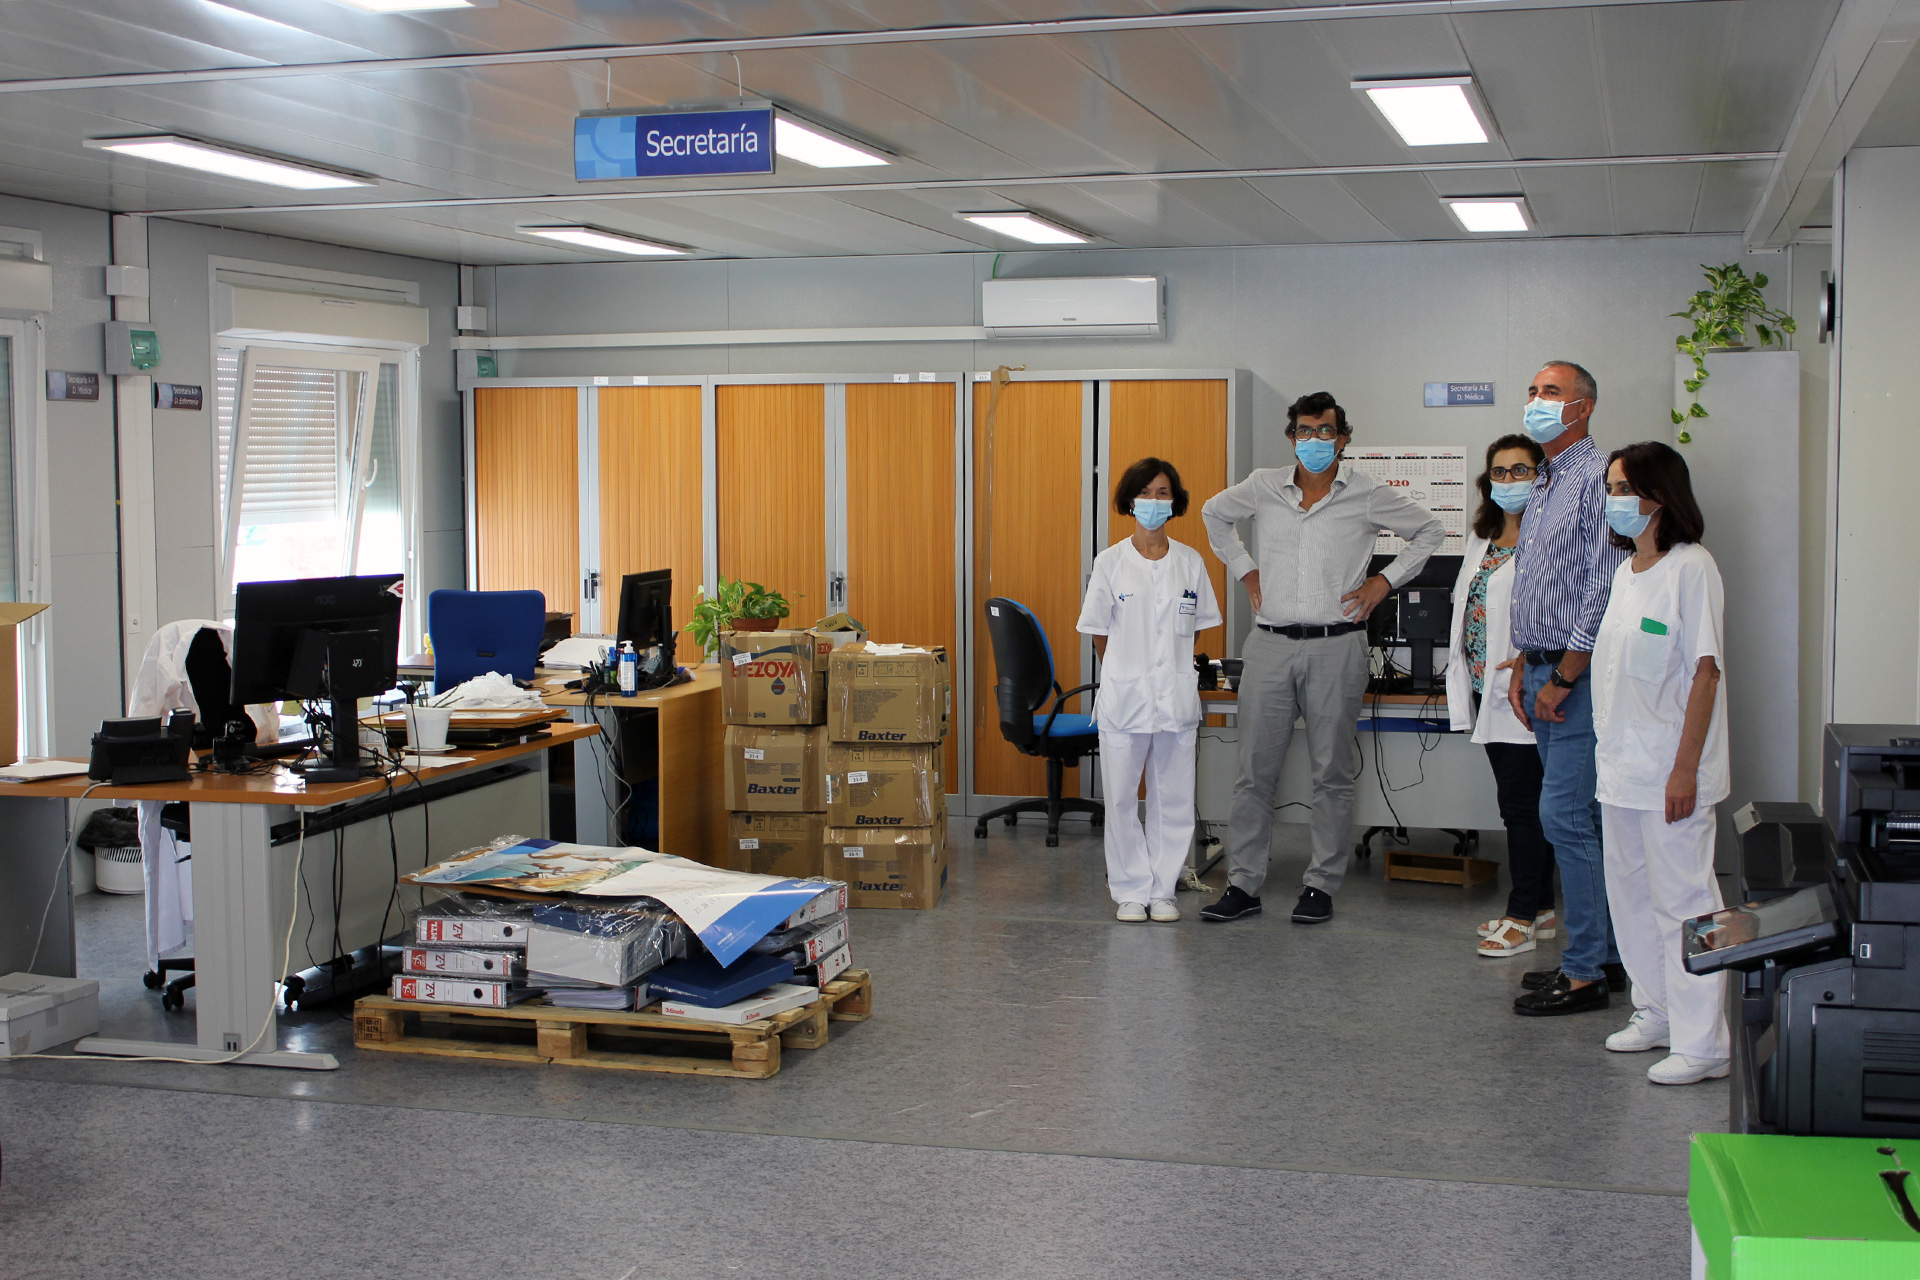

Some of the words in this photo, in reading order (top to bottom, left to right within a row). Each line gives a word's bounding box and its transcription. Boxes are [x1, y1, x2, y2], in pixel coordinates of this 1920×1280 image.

[646, 122, 758, 157] Secretaría
[1450, 384, 1478, 392] Secretaría
[1464, 393, 1484, 401] Médica
[857, 731, 907, 741] Baxter
[747, 783, 801, 795] Baxter
[855, 815, 904, 825] Baxter
[852, 880, 907, 892] Baxter
